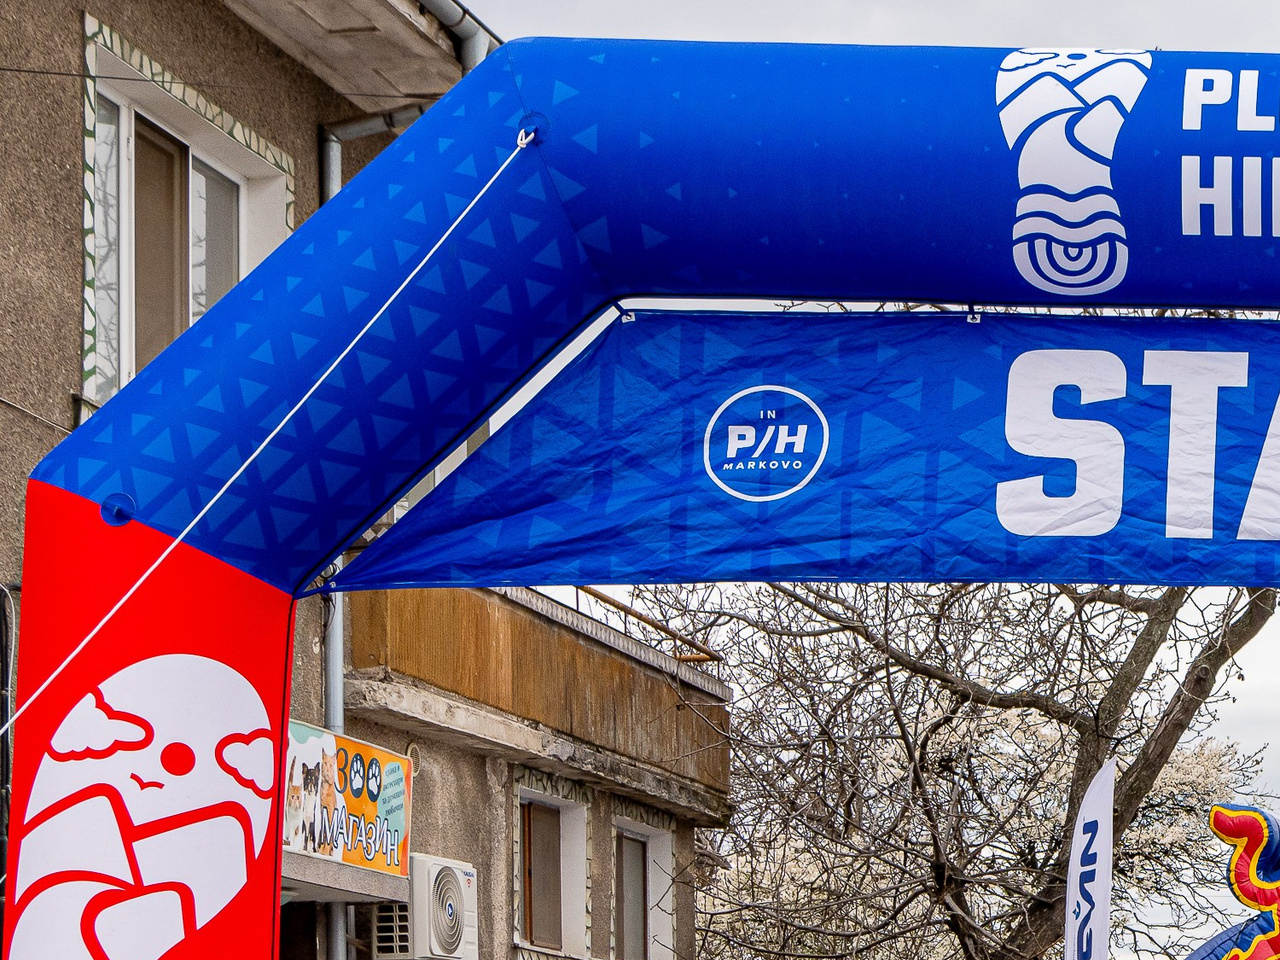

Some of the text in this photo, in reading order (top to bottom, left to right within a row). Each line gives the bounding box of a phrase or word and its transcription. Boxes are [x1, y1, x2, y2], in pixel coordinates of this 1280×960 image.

[760, 410, 776, 419] IN
[726, 425, 808, 459] P/H
[722, 460, 802, 471] MARKOVO
[320, 805, 400, 867] МАГАЗИН
